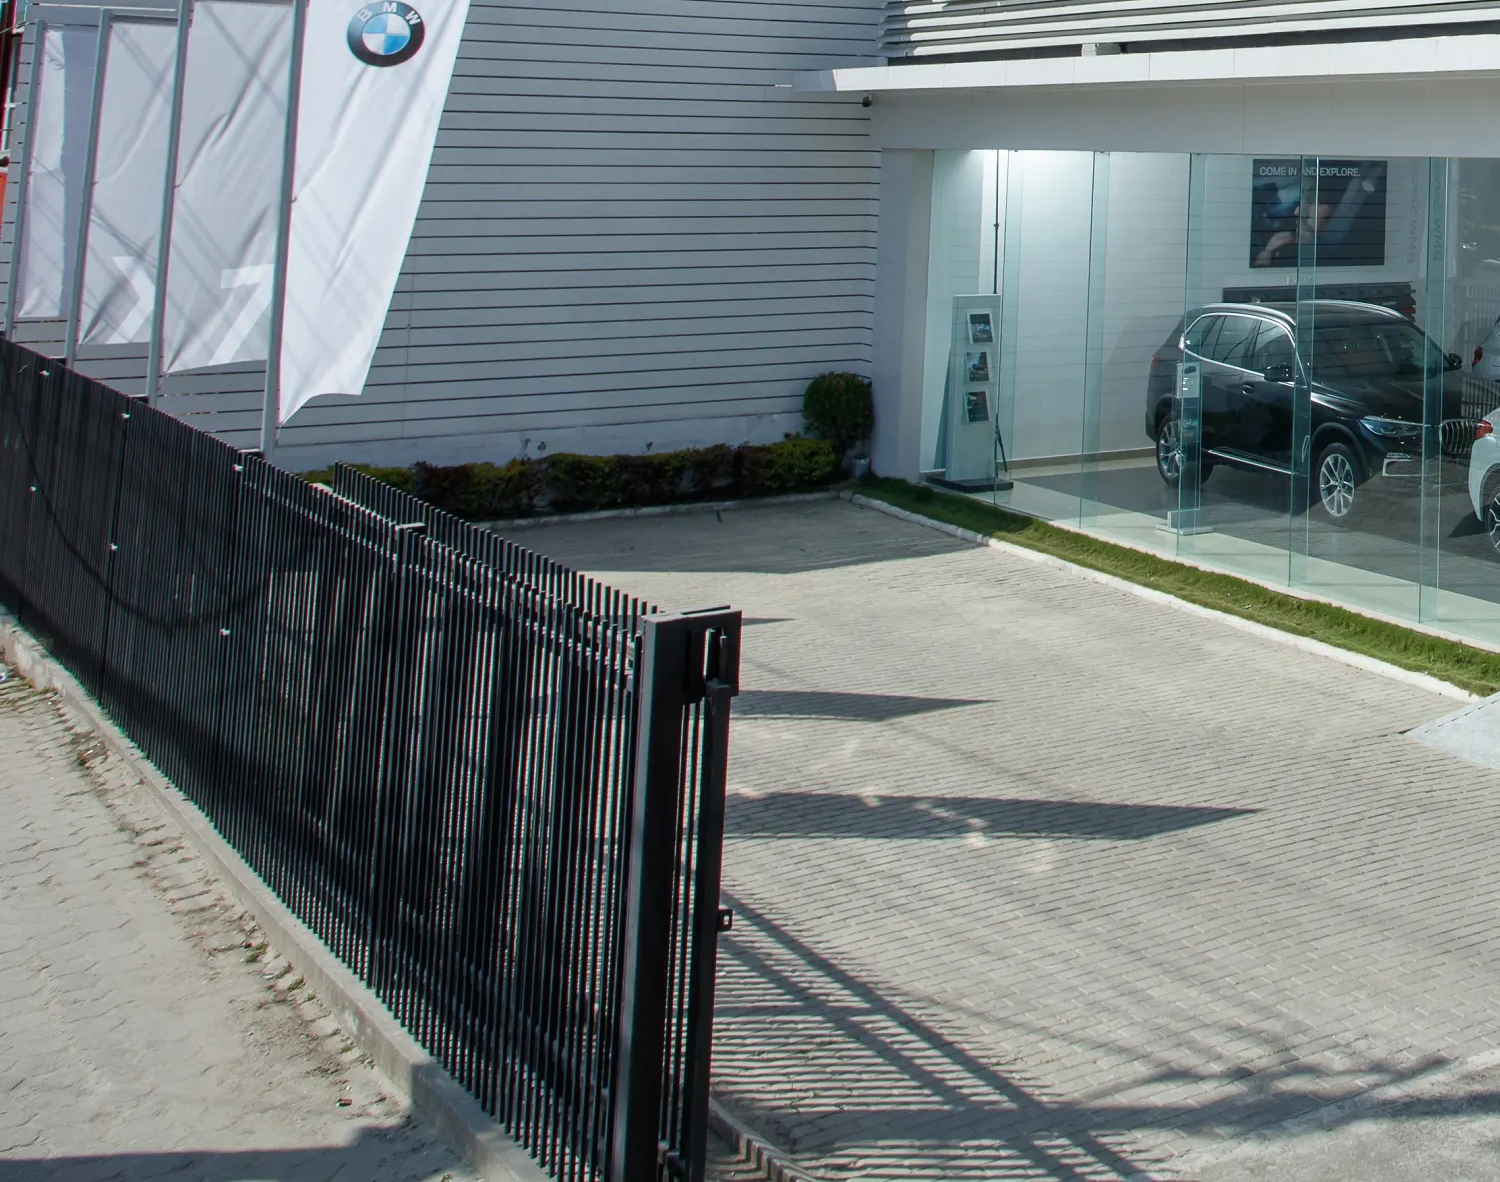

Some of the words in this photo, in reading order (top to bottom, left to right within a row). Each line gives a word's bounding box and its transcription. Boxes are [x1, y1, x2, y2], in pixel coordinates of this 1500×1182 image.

[357, 0, 422, 26] BMW
[1259, 166, 1286, 176] COME
[1288, 166, 1297, 176] IN
[1319, 167, 1360, 177] EXPLORE.
